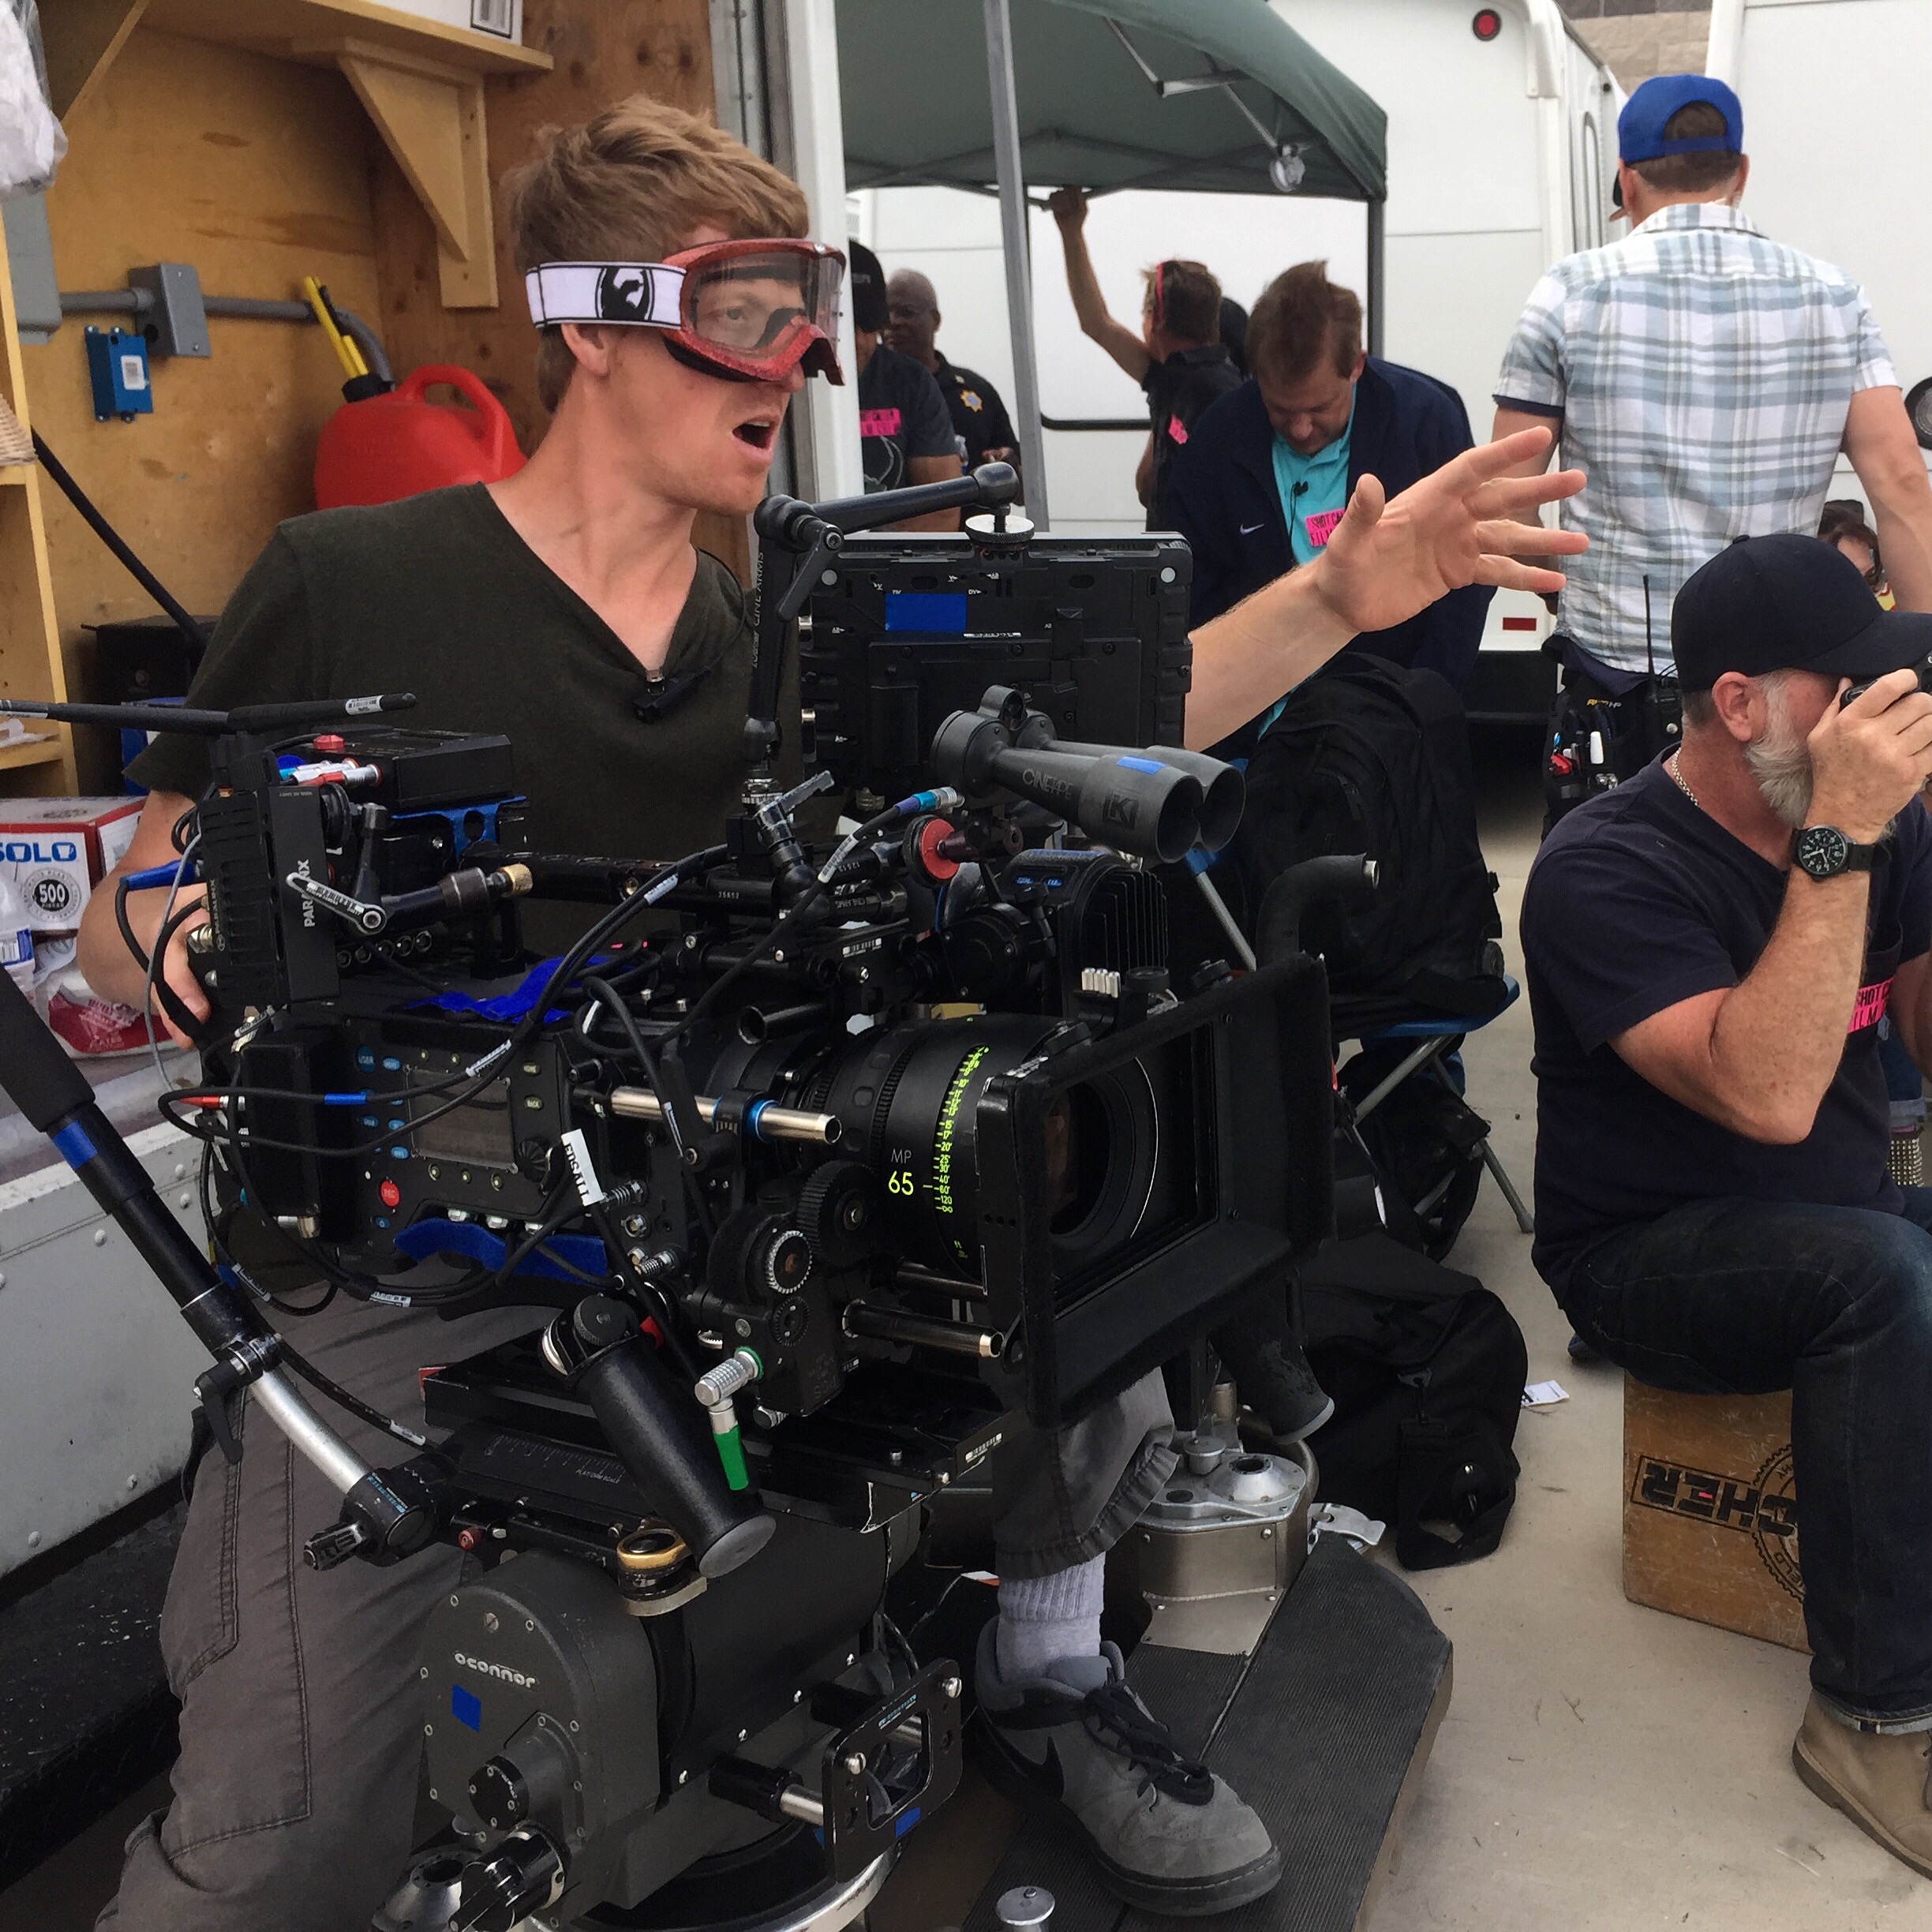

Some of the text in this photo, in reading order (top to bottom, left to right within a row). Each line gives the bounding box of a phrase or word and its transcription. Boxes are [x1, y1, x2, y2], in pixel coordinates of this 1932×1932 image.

[0, 841, 77, 863] OLO
[39, 883, 66, 903] 500
[891, 1148, 912, 1164] MP
[888, 1170, 914, 1196] 65
